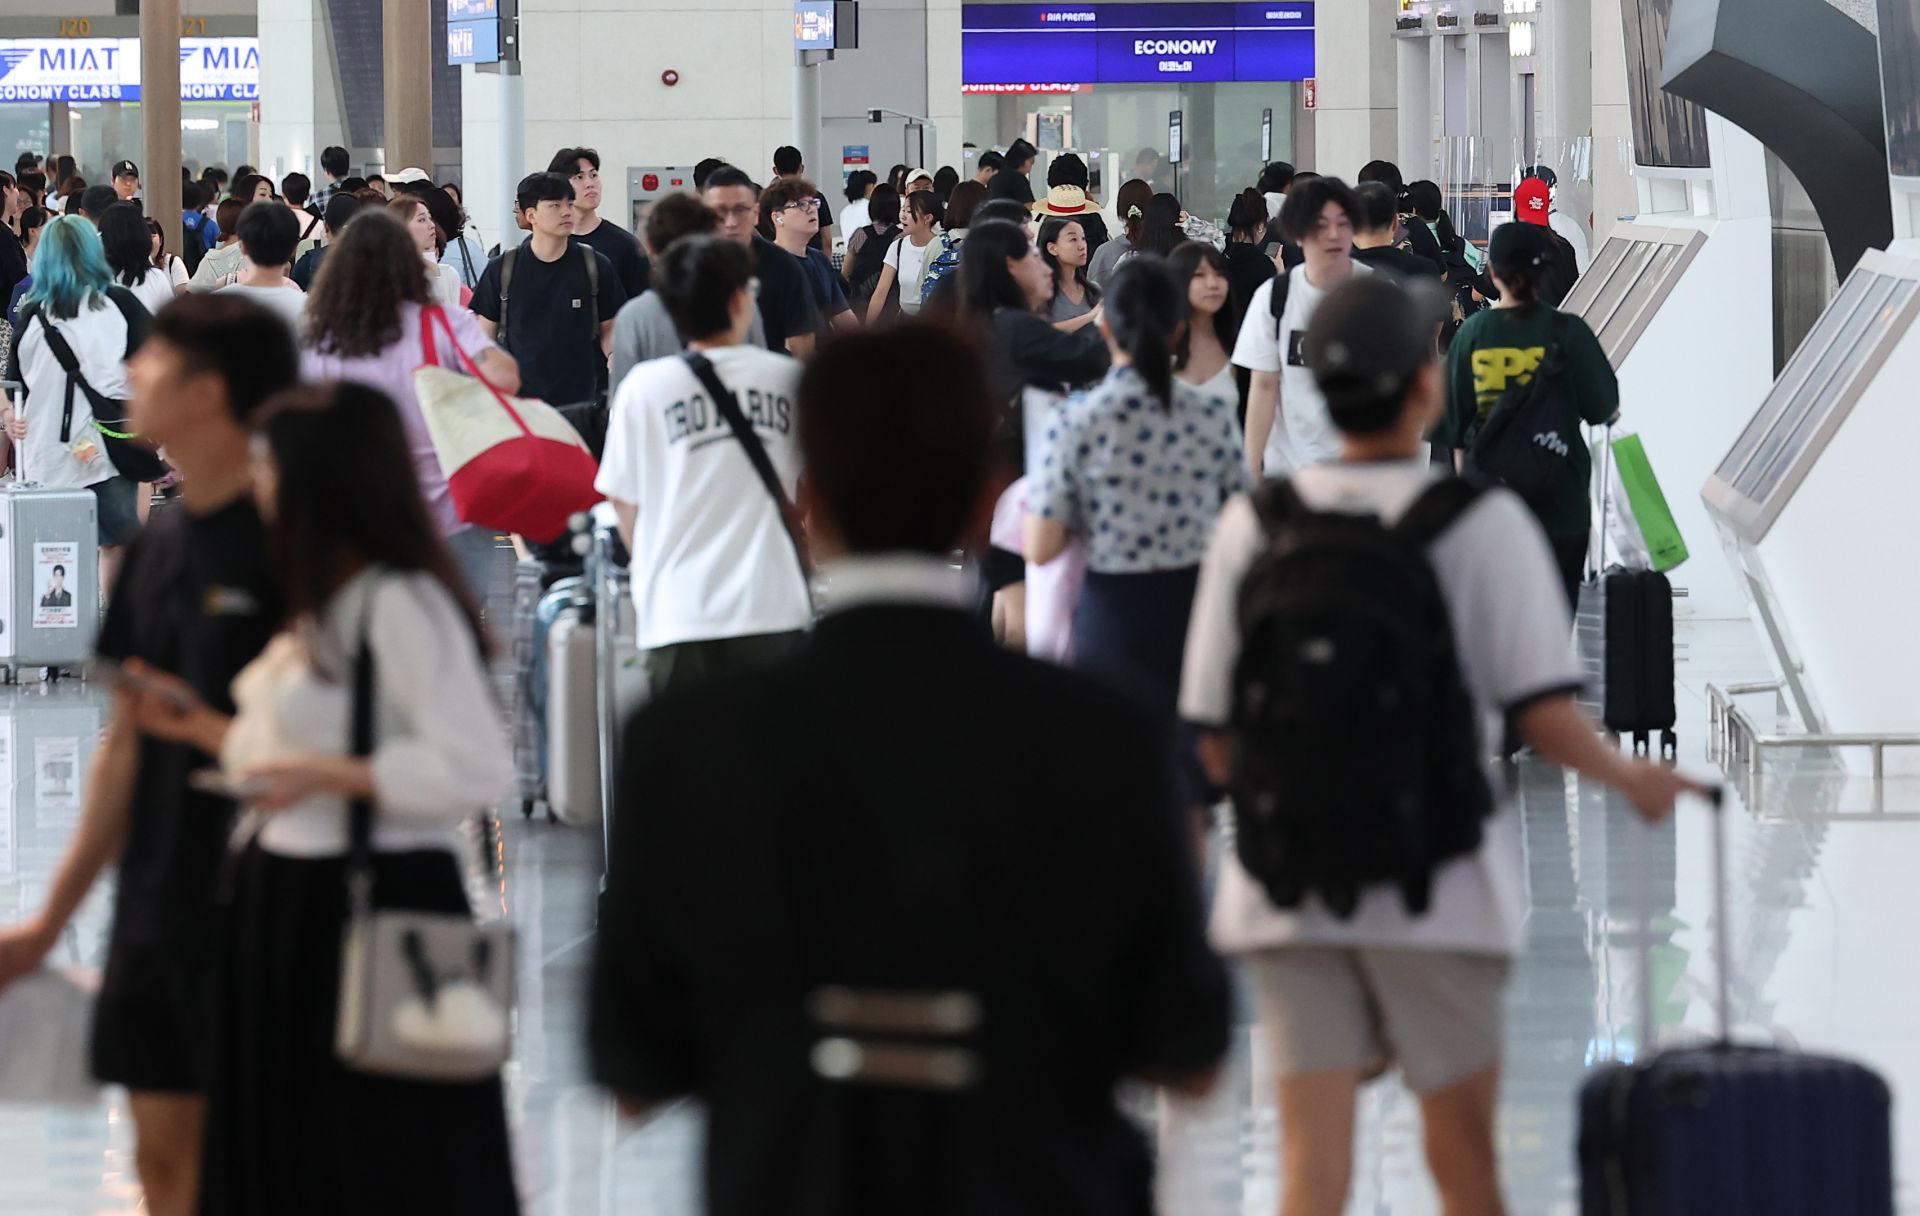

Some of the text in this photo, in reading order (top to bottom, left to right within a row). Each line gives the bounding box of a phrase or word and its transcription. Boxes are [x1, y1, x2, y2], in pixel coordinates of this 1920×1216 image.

[1047, 13, 1096, 21] AIR PREMIA
[59, 17, 92, 36] J20
[1134, 40, 1217, 54] ECONOMY
[40, 48, 119, 70] MIAT
[68, 85, 121, 99] CLASS
